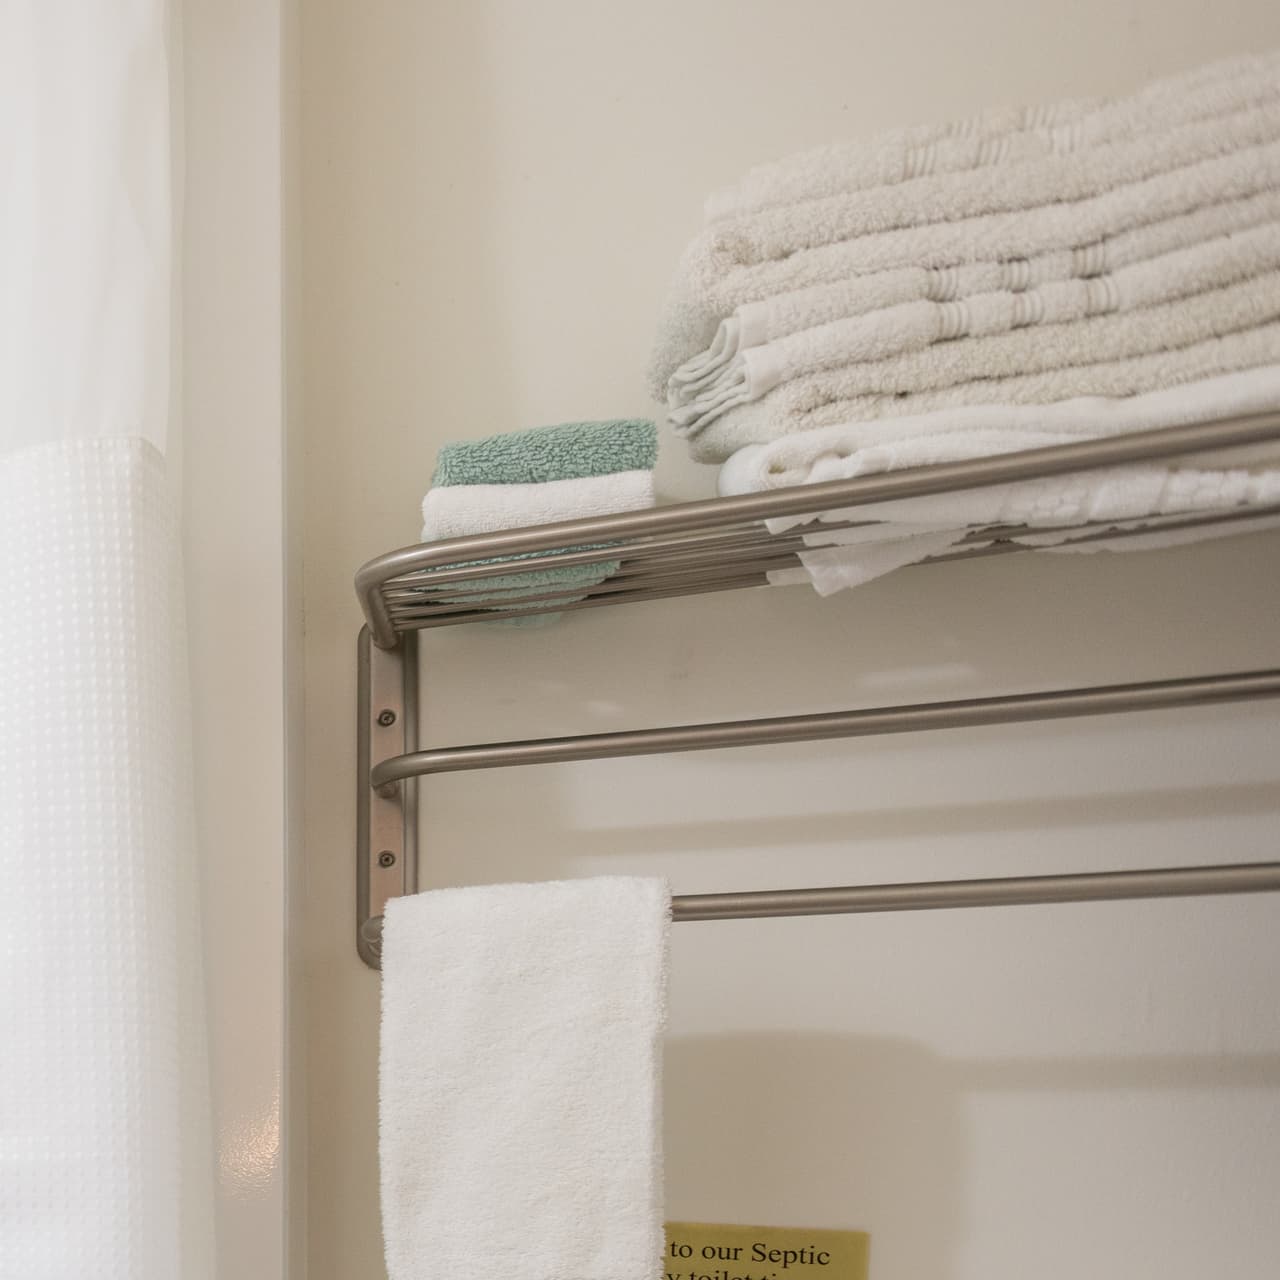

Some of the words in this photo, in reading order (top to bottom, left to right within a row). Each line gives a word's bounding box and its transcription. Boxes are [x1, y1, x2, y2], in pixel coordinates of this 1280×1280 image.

[670, 1240, 694, 1259] to
[701, 1245, 744, 1261] our
[751, 1242, 831, 1269] Septic
